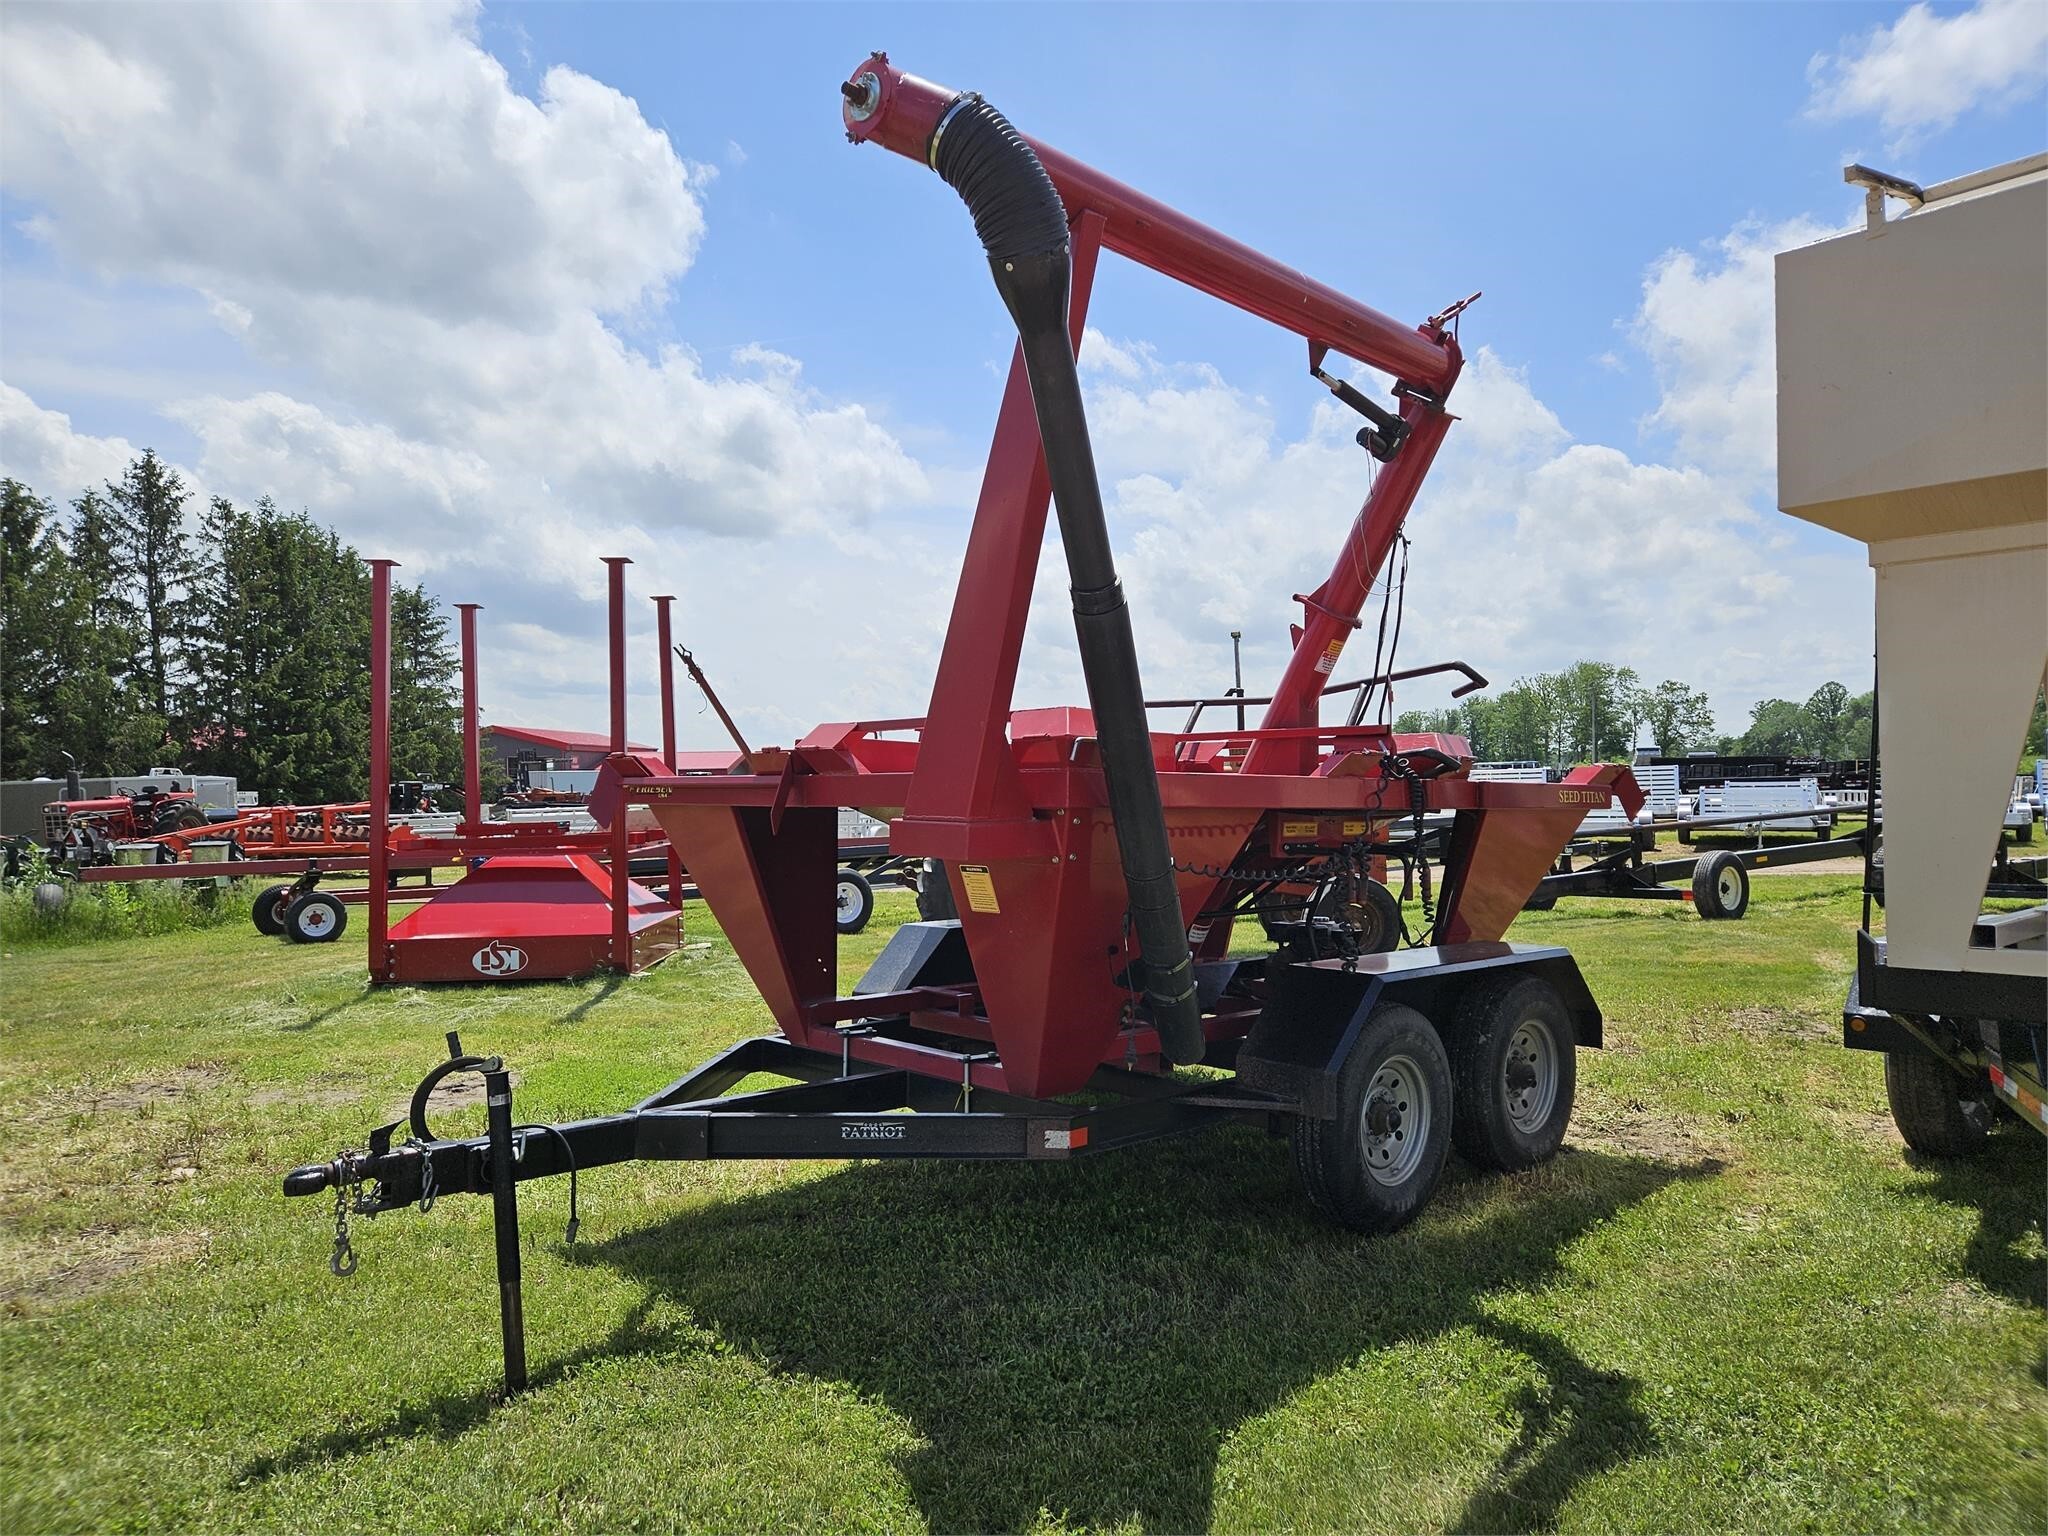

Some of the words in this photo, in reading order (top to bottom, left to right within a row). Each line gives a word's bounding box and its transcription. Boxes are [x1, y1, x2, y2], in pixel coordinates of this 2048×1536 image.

[1558, 790, 1580, 803] SEED
[1580, 791, 1605, 804] TITAN
[841, 1126, 906, 1138] PATRIOT
